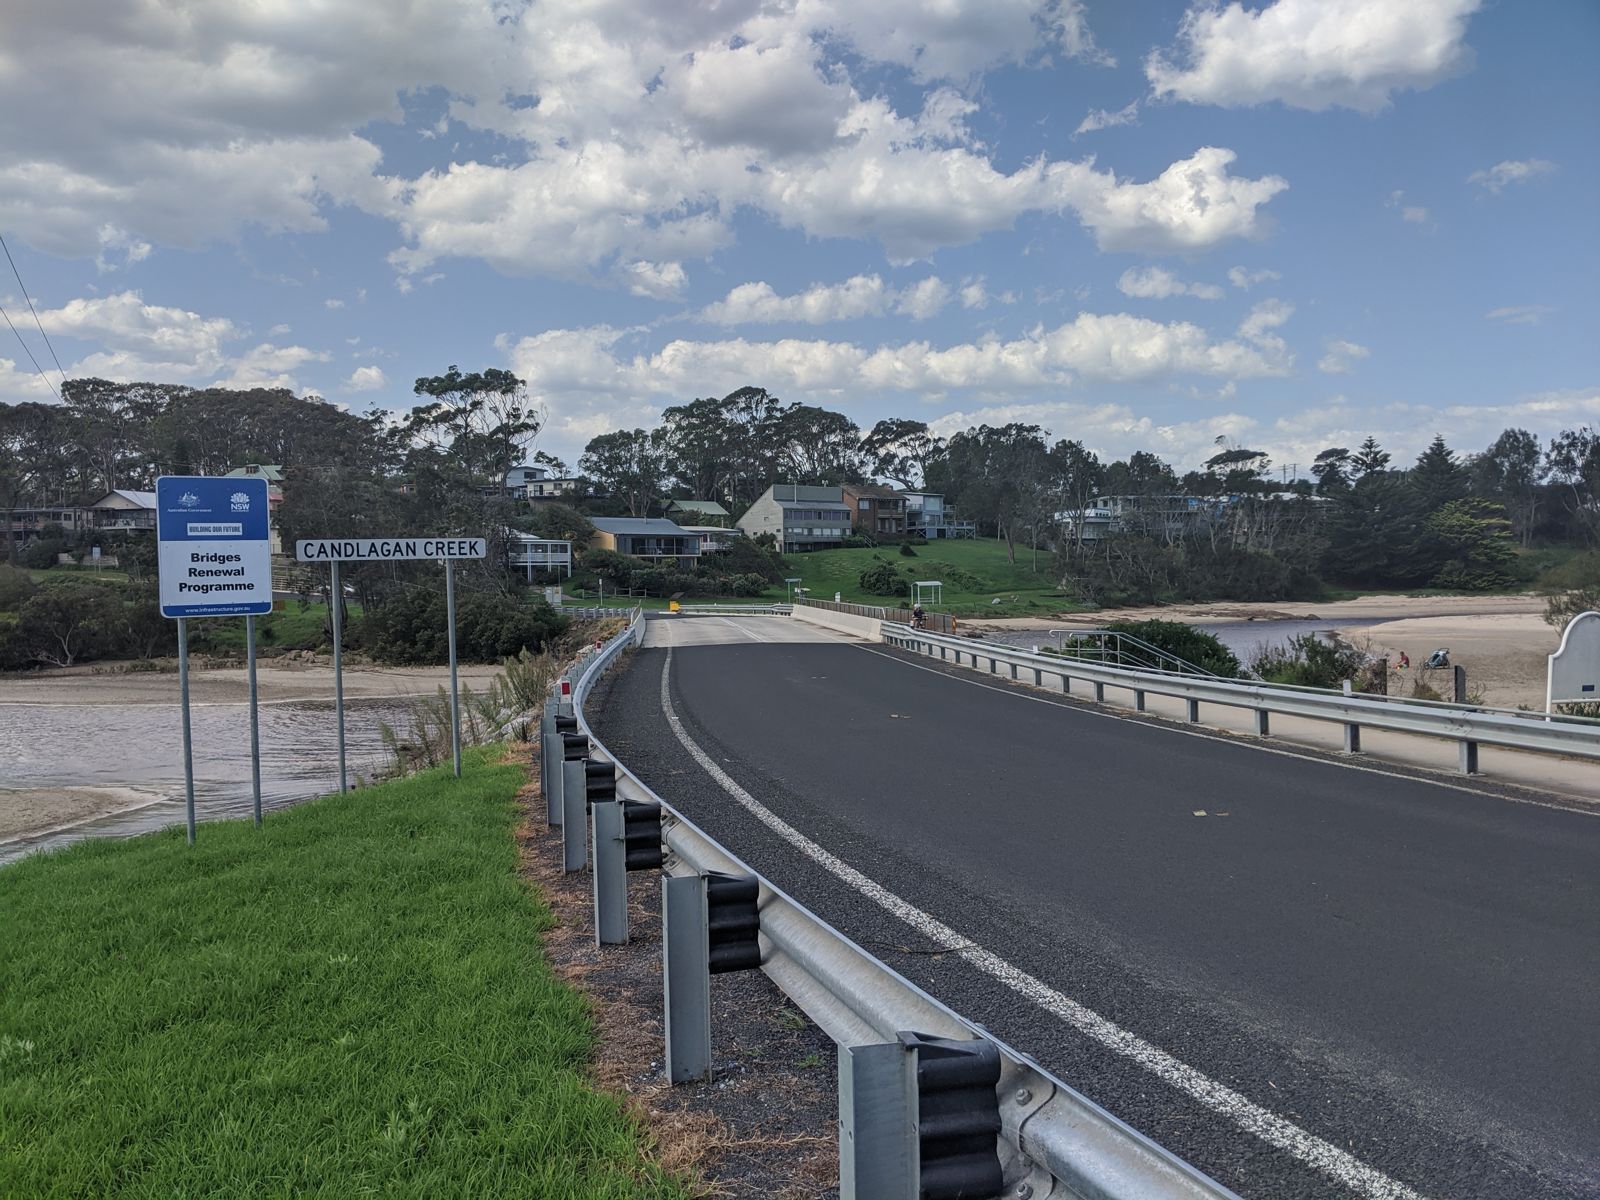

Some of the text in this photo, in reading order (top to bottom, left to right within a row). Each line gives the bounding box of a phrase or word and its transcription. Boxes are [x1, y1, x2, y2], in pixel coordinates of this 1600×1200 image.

[304, 540, 479, 559] CANDLAGAN CREEK
[191, 552, 241, 564] Bridges
[188, 567, 245, 577] Renewal
[179, 582, 255, 594] Programme
